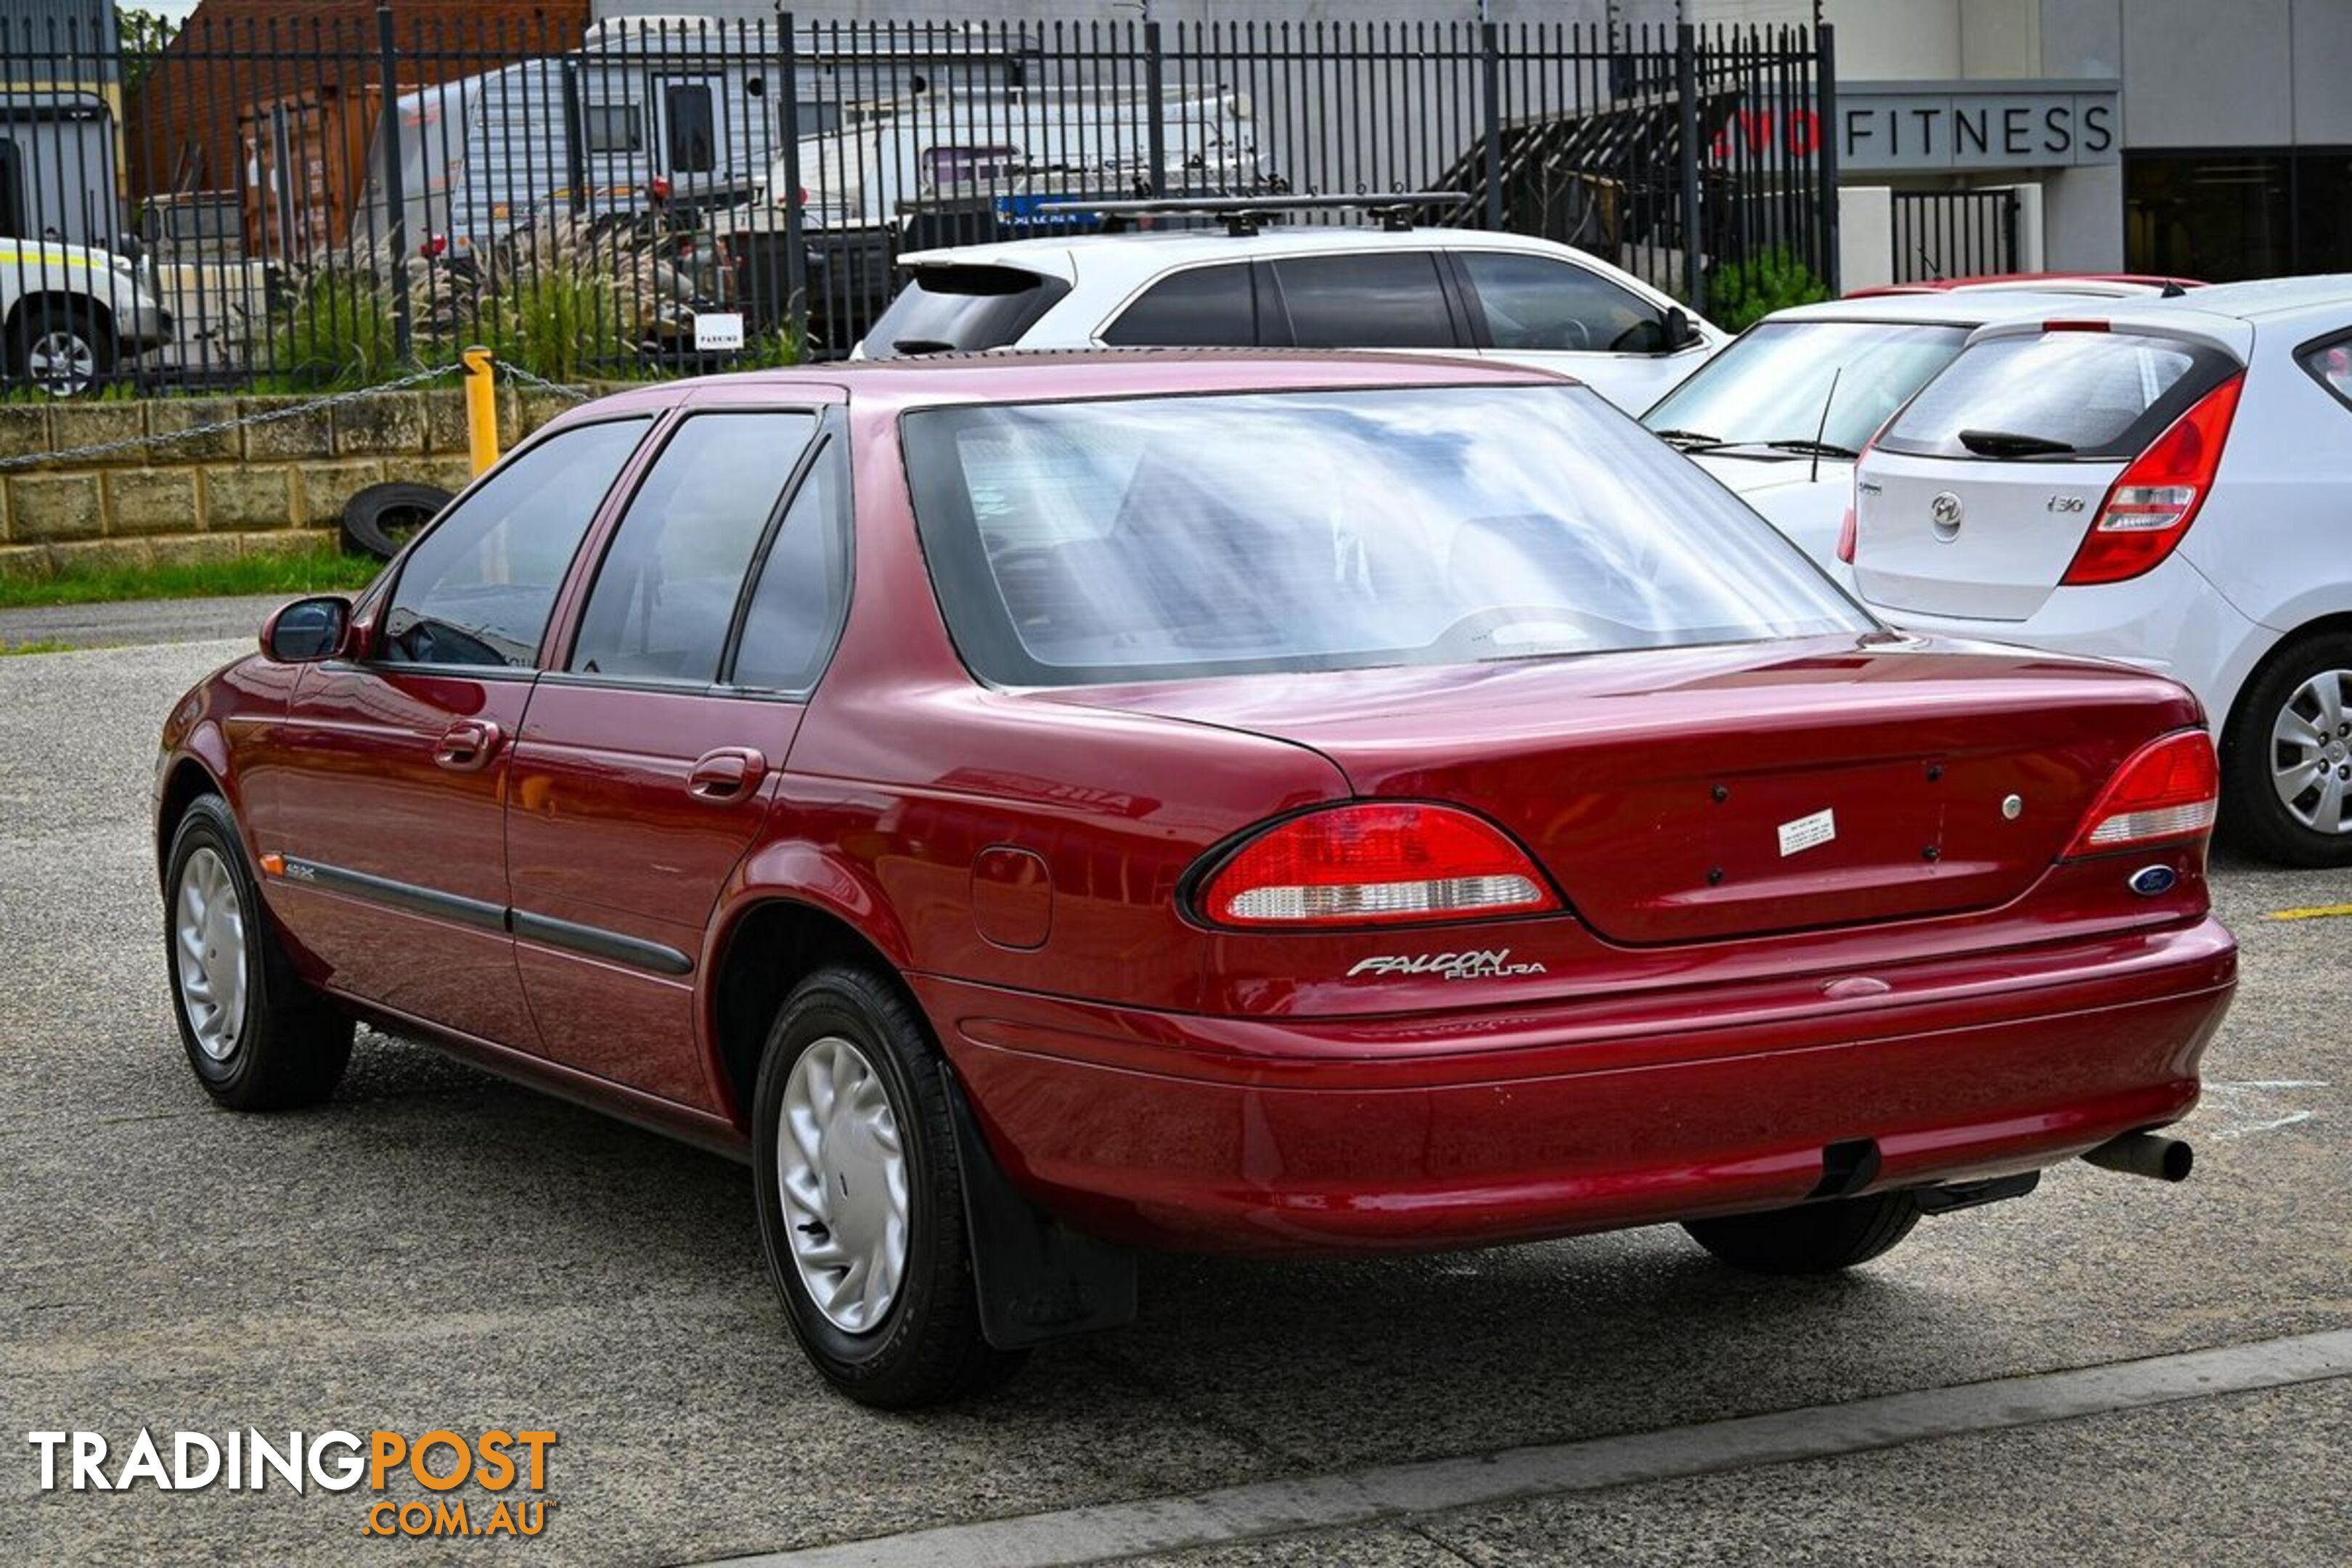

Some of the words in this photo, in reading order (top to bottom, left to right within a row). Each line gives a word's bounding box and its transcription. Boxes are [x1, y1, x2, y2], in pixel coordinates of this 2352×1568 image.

[1847, 107, 2112, 156] FITNESS
[1347, 948, 1511, 977] FALCON
[1445, 962, 1547, 980] FUTURA
